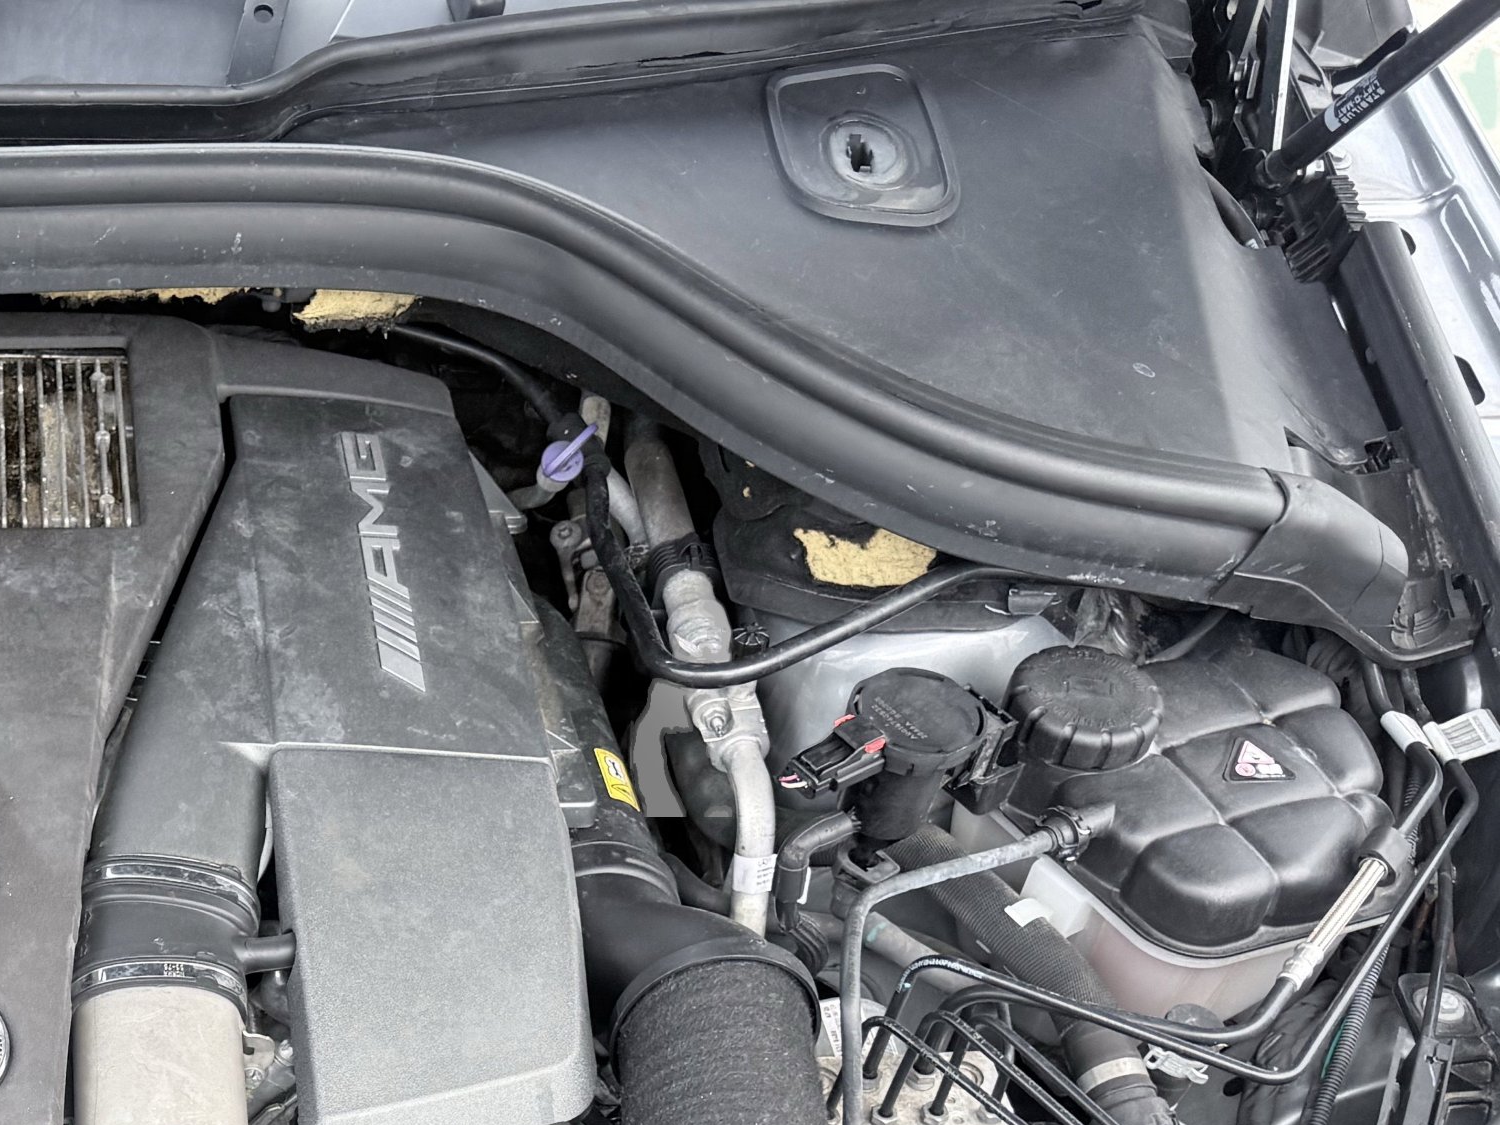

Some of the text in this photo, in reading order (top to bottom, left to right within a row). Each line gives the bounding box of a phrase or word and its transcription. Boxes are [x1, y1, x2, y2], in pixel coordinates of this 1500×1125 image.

[1338, 79, 1379, 117] LIFT-O-MAT
[1340, 87, 1384, 123] STABILUS
[340, 431, 409, 596] AMG
